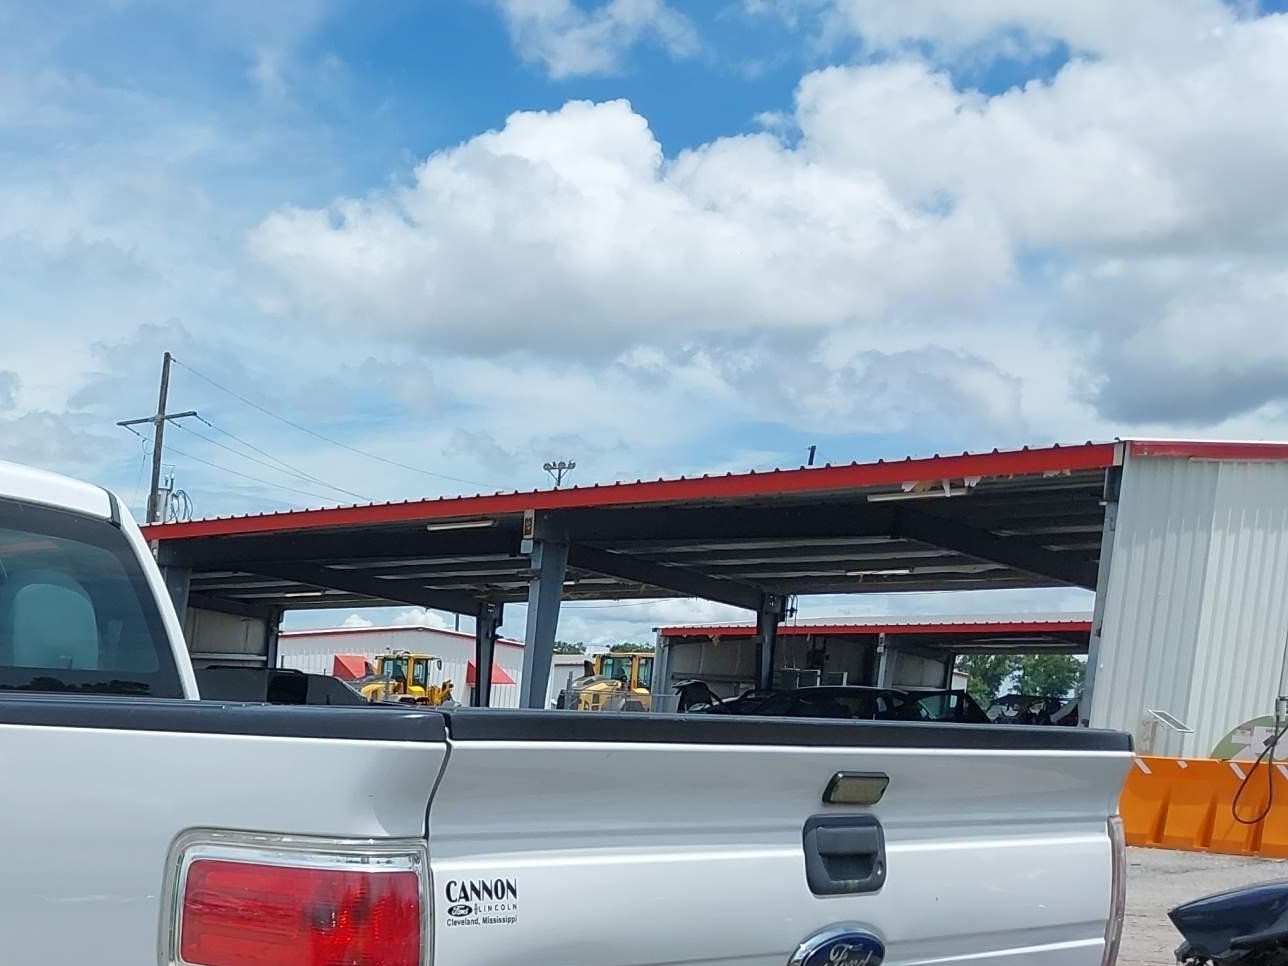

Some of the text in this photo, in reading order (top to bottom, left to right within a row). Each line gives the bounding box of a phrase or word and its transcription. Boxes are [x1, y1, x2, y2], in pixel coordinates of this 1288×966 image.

[445, 878, 518, 903] CANNON
[478, 903, 518, 913] LINCOLN
[446, 915, 518, 927] Cleveland, Mississippi
